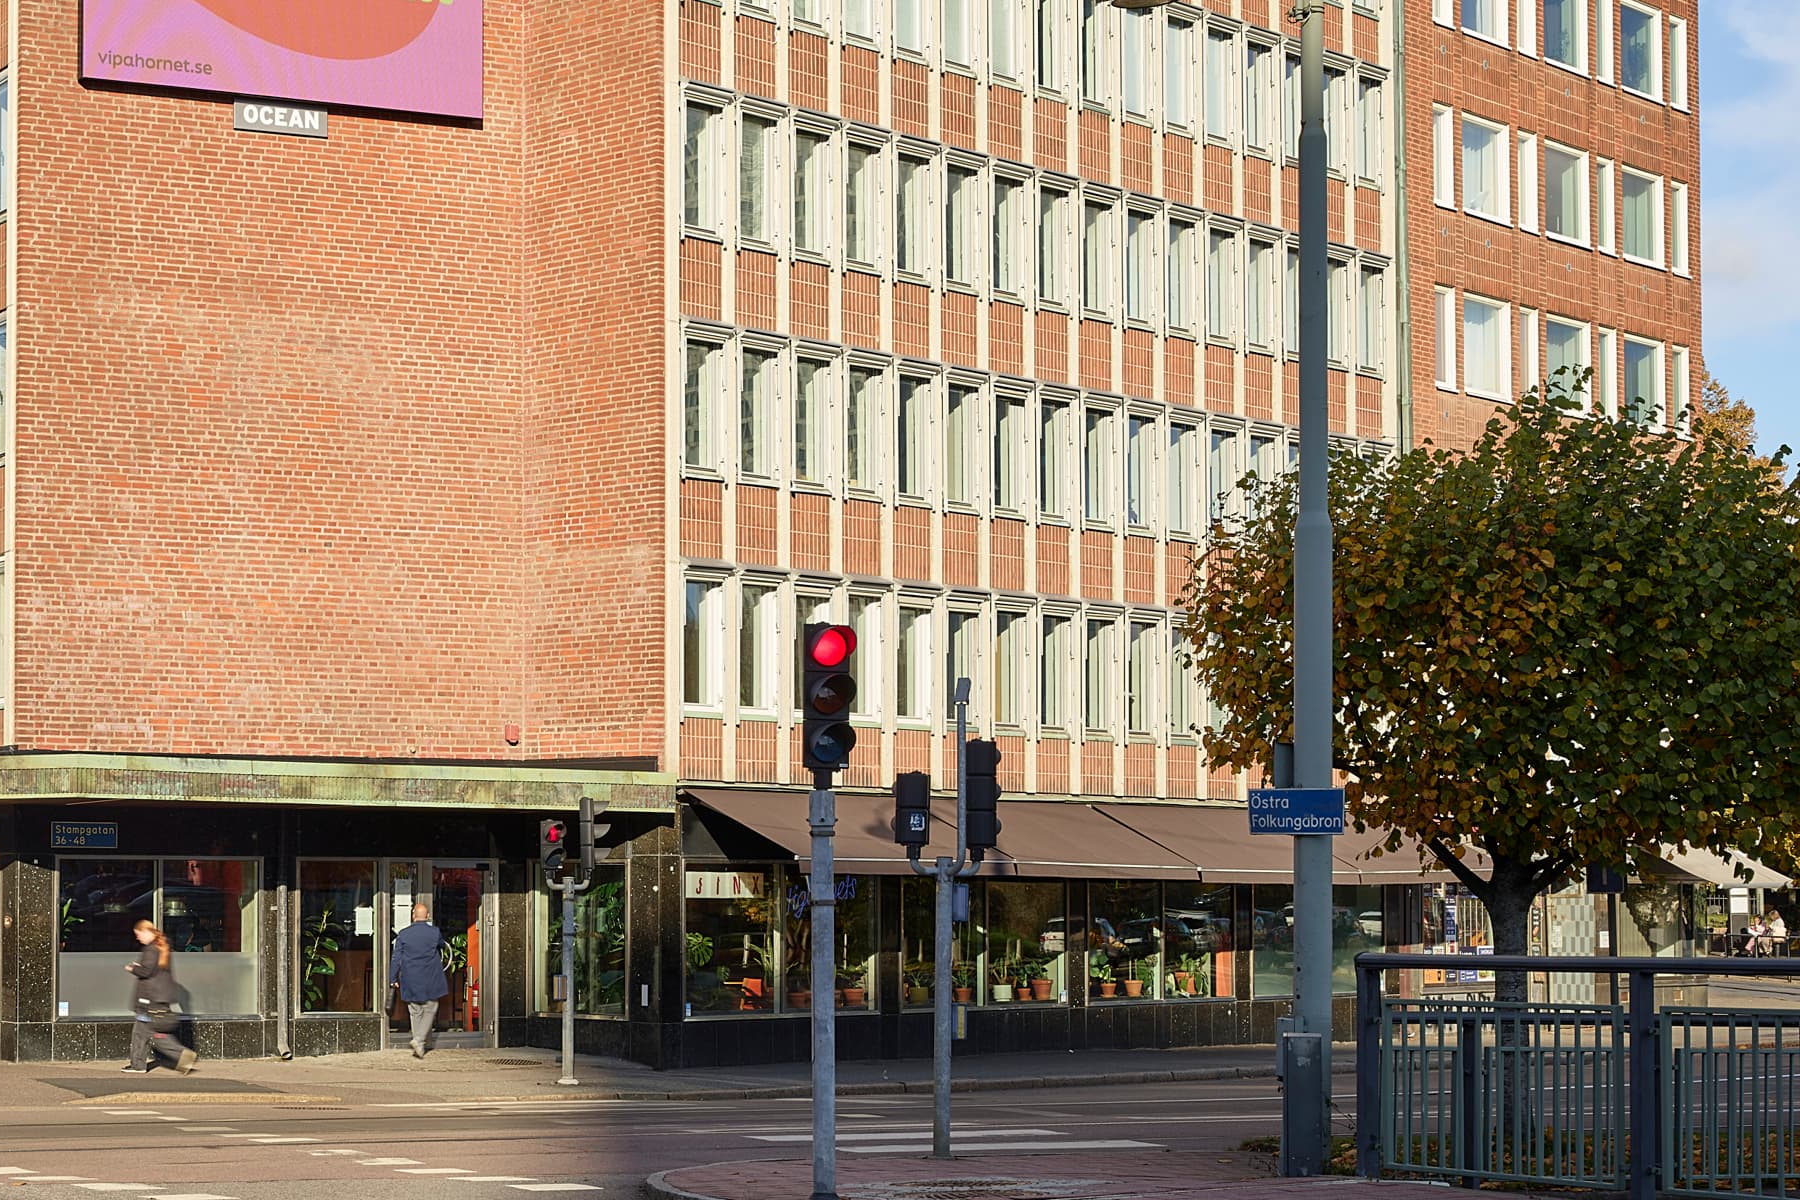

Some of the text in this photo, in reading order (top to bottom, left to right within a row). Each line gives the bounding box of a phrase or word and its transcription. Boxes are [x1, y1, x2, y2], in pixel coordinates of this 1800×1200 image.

[98, 50, 213, 75] vipahornet.se
[243, 104, 319, 130] OCEAN
[1250, 793, 1289, 809] Östra
[55, 824, 115, 836] Stampgatan
[1251, 813, 1342, 831] Folkungabron
